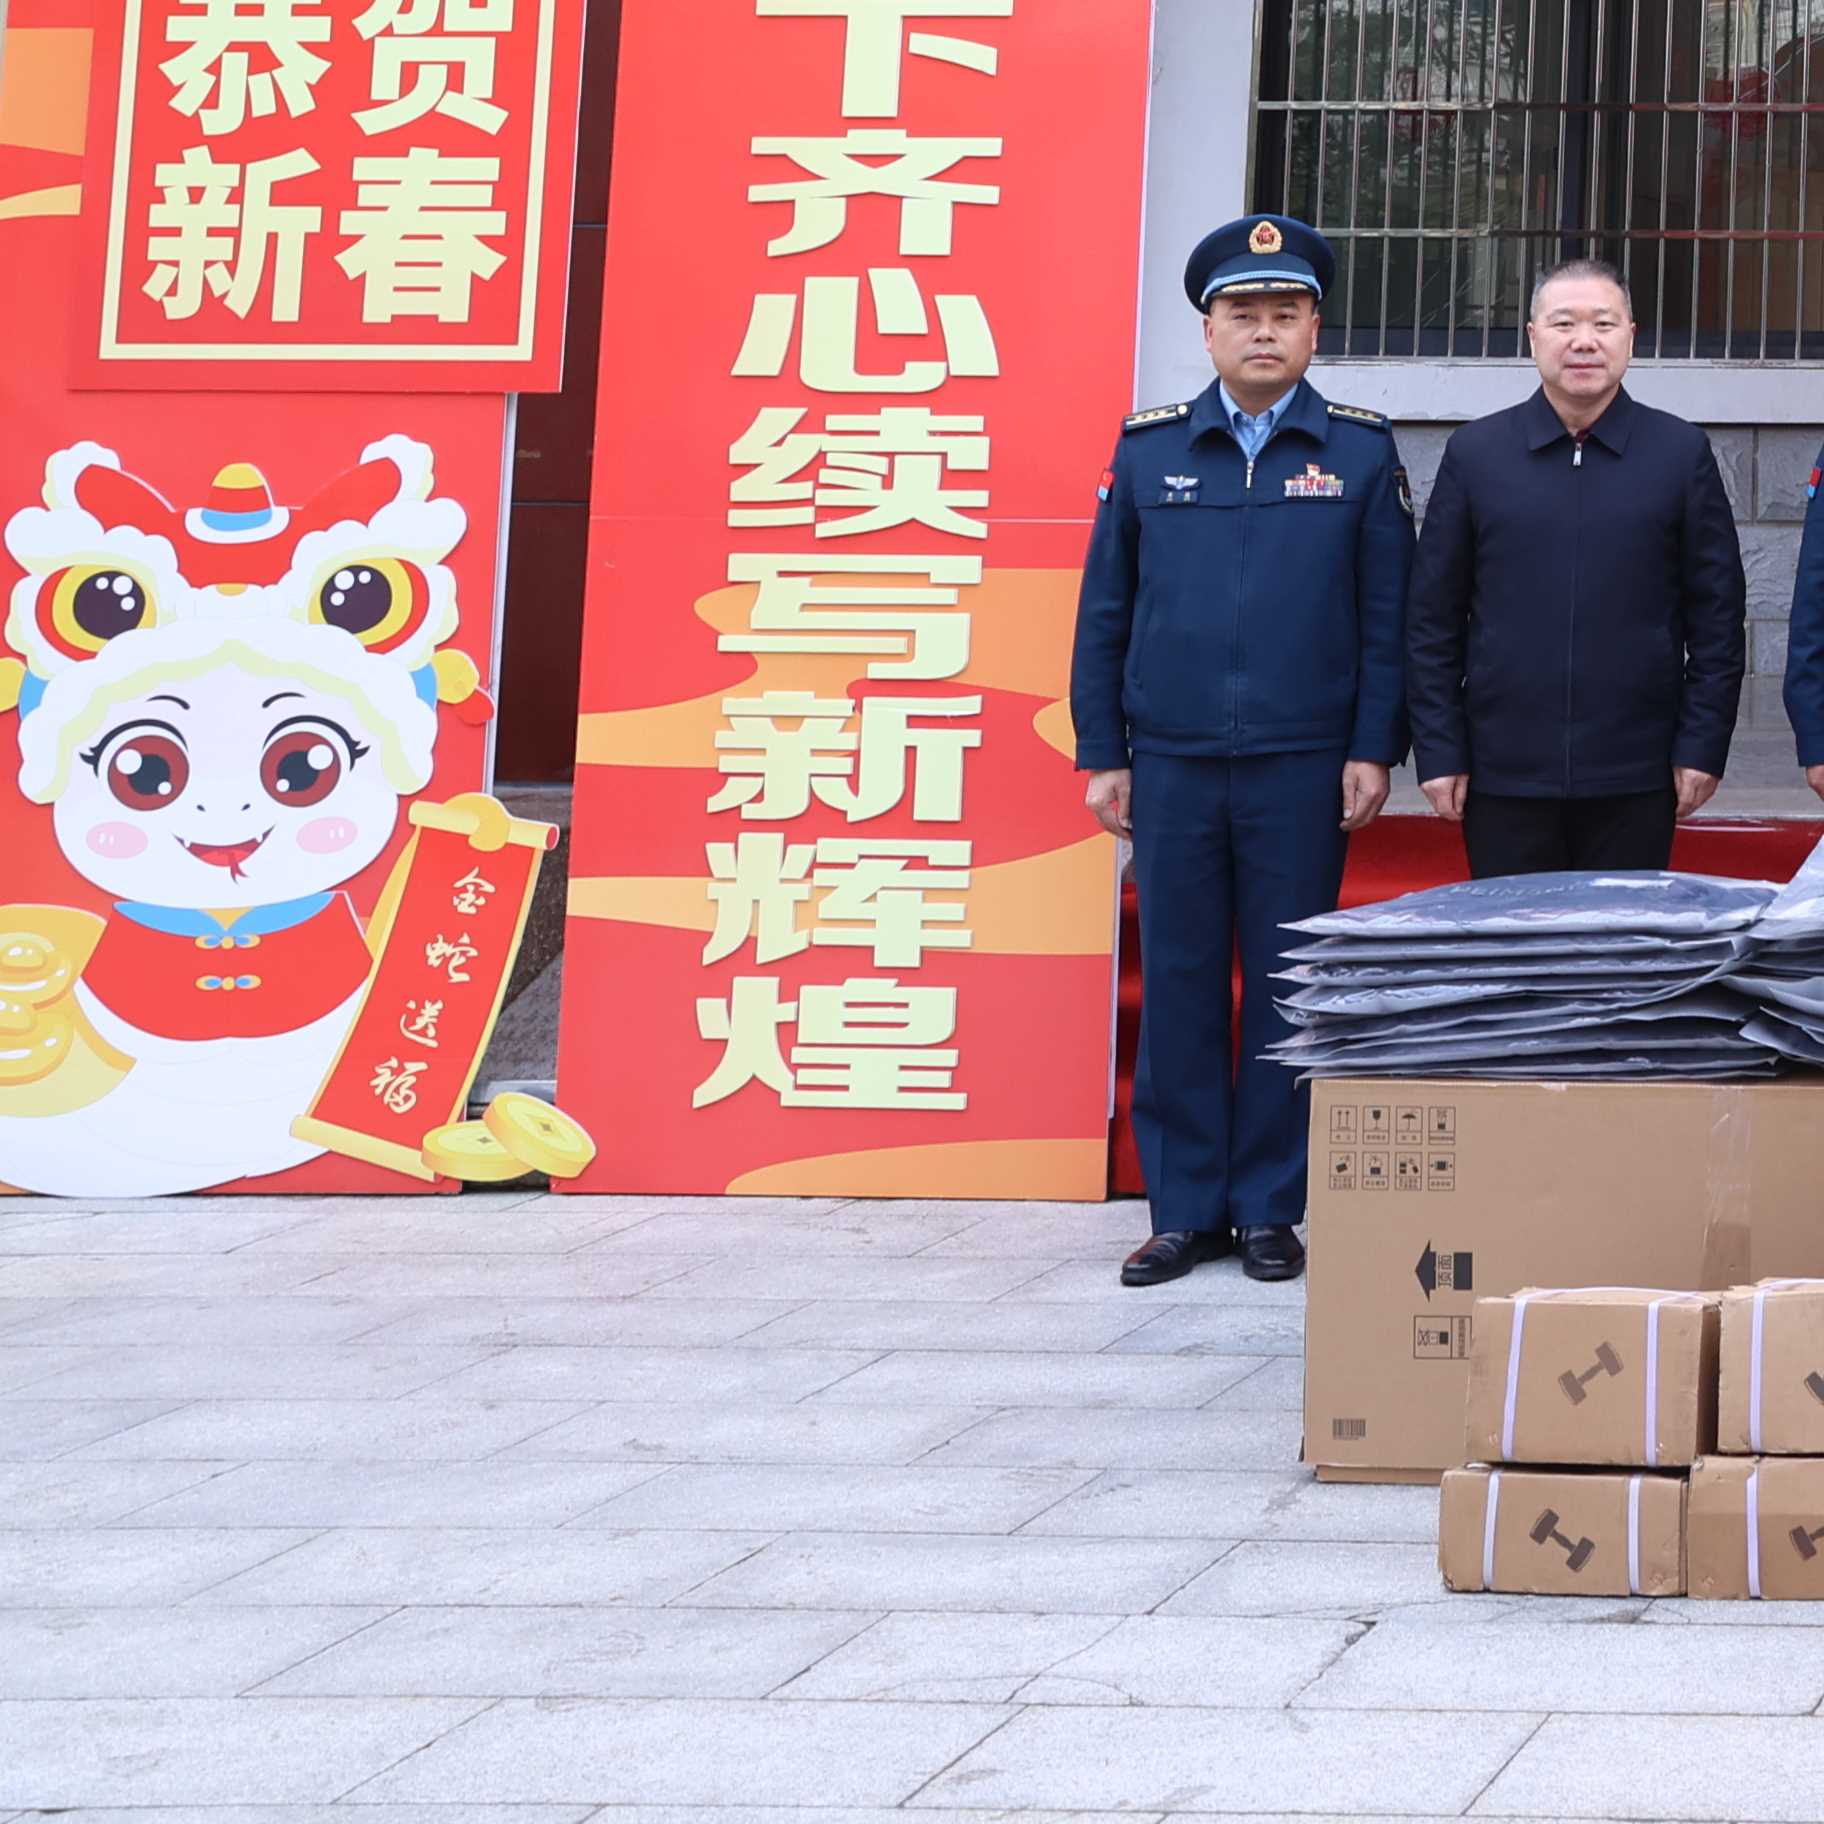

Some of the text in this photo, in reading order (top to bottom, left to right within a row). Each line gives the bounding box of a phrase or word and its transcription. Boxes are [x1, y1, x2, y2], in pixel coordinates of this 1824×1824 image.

[142, 145, 507, 323] 新春
[369, 866, 496, 1114] 金蛇送福
